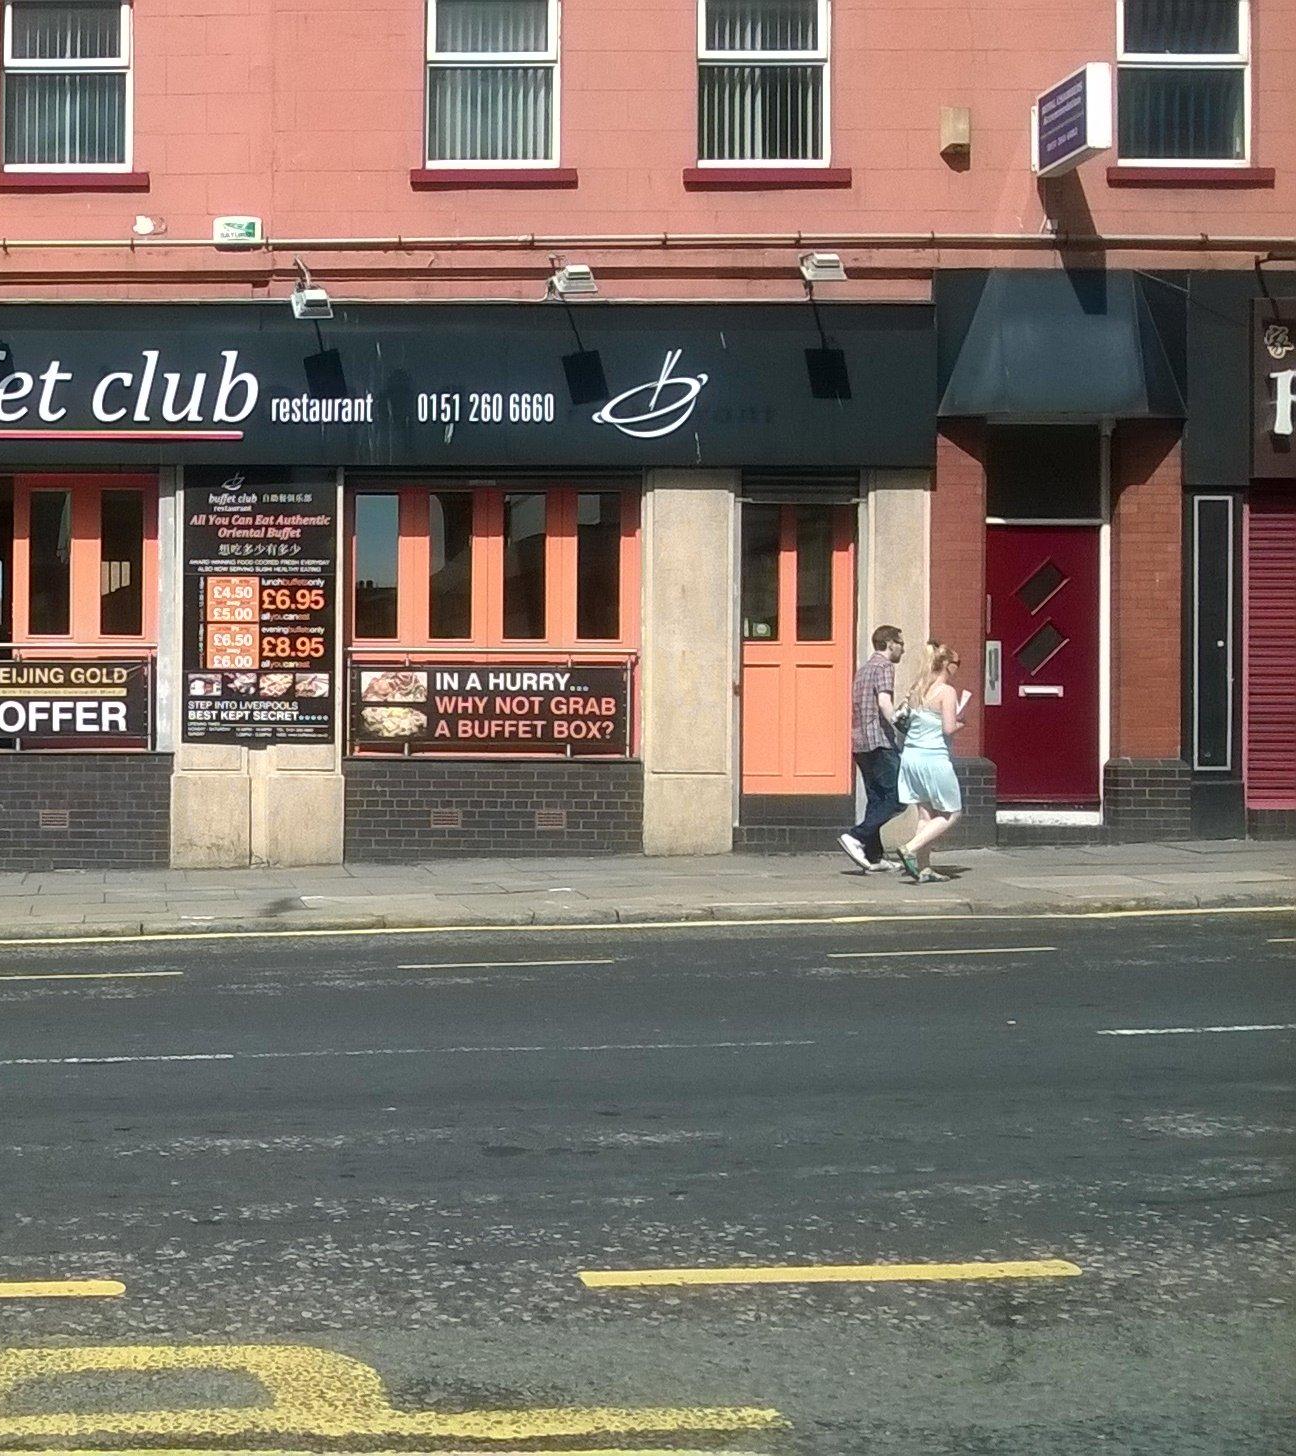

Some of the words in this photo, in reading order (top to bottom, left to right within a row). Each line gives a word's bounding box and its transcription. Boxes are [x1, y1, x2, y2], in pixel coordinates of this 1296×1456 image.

[91, 350, 259, 423] club
[271, 392, 373, 423] restaurant
[417, 393, 460, 423] 0151
[469, 393, 503, 423] 260
[509, 393, 554, 423] 6660
[208, 493, 236, 505] buffet
[238, 493, 258, 503] club
[190, 514, 206, 525] All
[208, 515, 229, 525] You
[231, 515, 253, 525] Can
[255, 515, 274, 525] Eat
[276, 514, 331, 525] Authentic
[218, 527, 266, 538] Oriental
[266, 527, 301, 540] Buffet
[213, 586, 253, 598] £4.50
[262, 589, 325, 609] £6.95
[213, 608, 253, 620] £5.00
[262, 637, 325, 657] £8.95
[70, 667, 128, 684] GOLD
[435, 672, 459, 691] IN
[465, 672, 482, 691] A
[188, 701, 212, 709] STEP
[214, 701, 238, 709] INTO
[239, 701, 299, 710] LIVERPOOLS
[435, 696, 488, 714] WHY
[495, 696, 547, 715] NOT
[550, 697, 616, 716] GRAB
[188, 710, 218, 720] BEST
[220, 710, 250, 720] KEPT
[434, 720, 451, 738] A
[458, 720, 547, 739] BUFFET
[553, 721, 615, 740] BOX?
